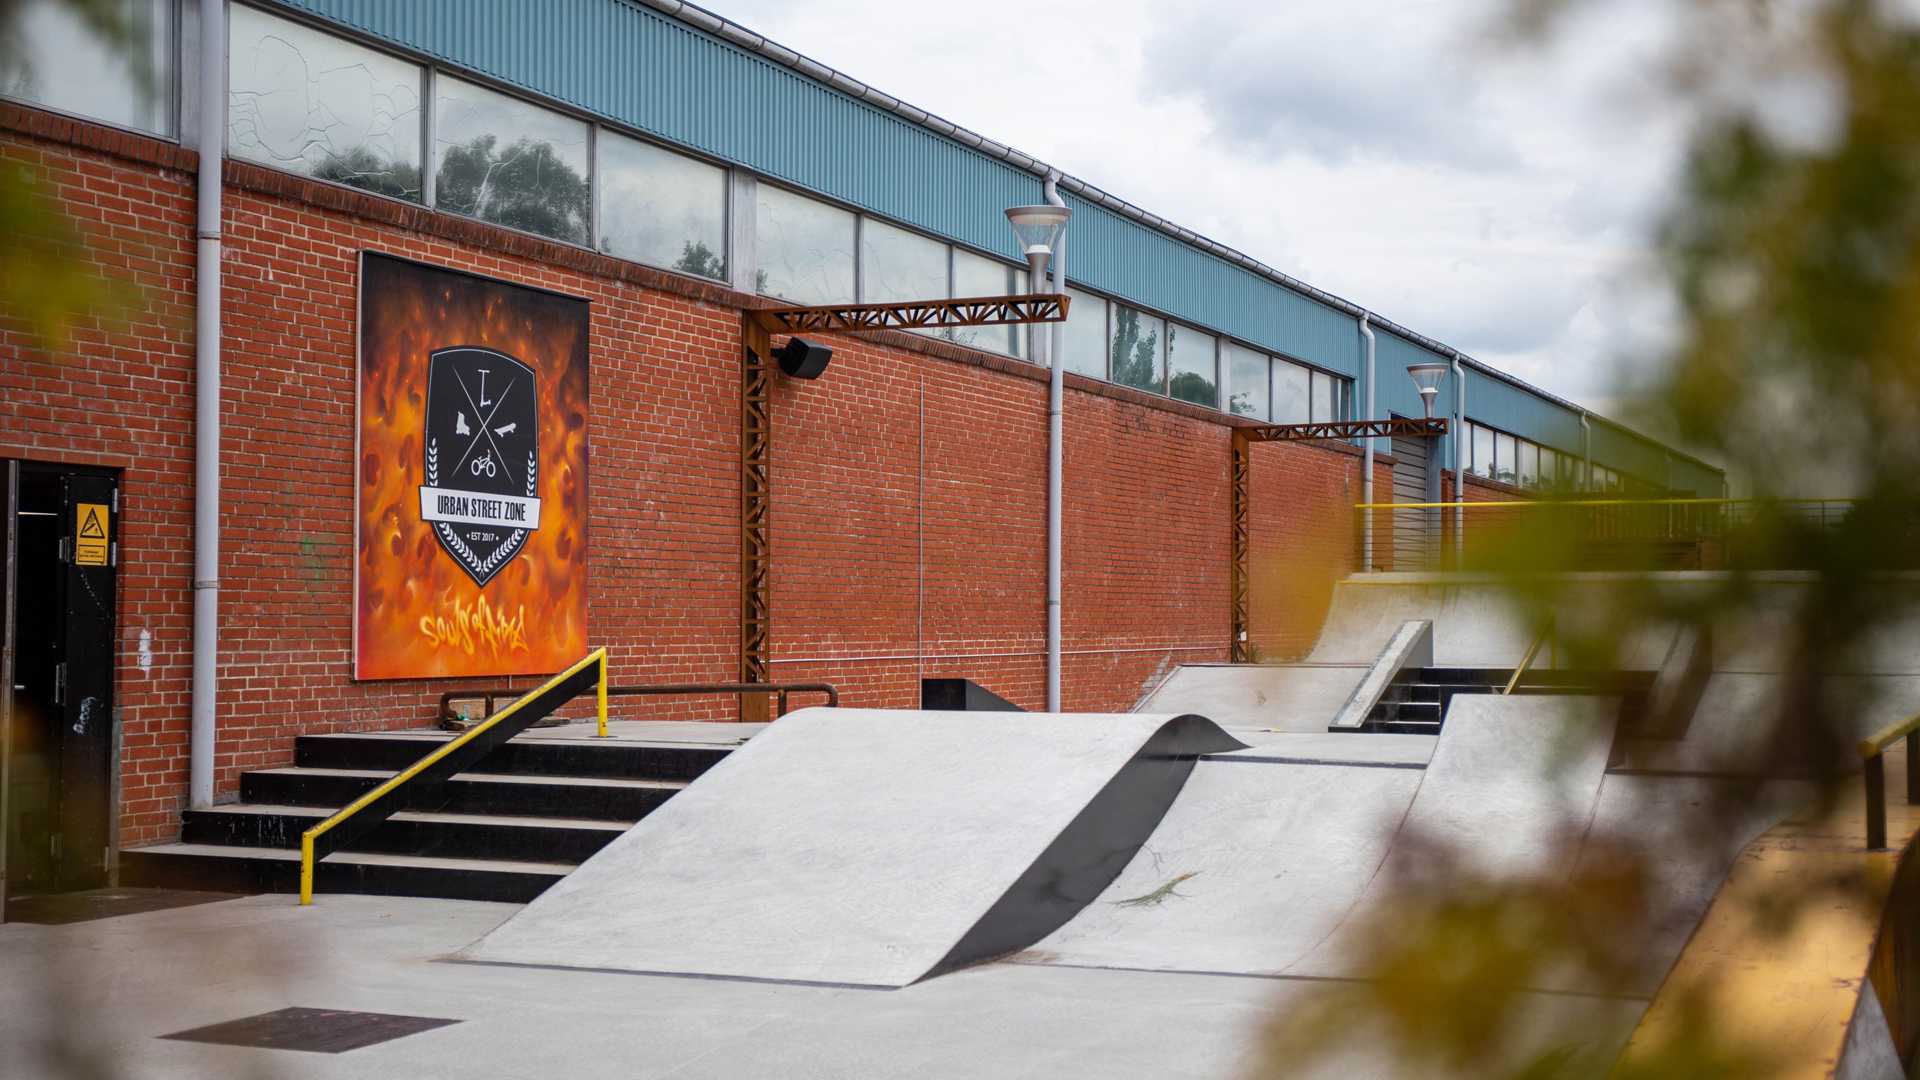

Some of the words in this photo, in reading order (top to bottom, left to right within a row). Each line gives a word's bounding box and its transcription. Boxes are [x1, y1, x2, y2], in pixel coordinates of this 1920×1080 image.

[437, 494, 469, 517] URBAN
[471, 498, 502, 519] STREET
[504, 501, 526, 521] ZONE
[471, 531, 481, 541] EST
[482, 532, 495, 542] 2017
